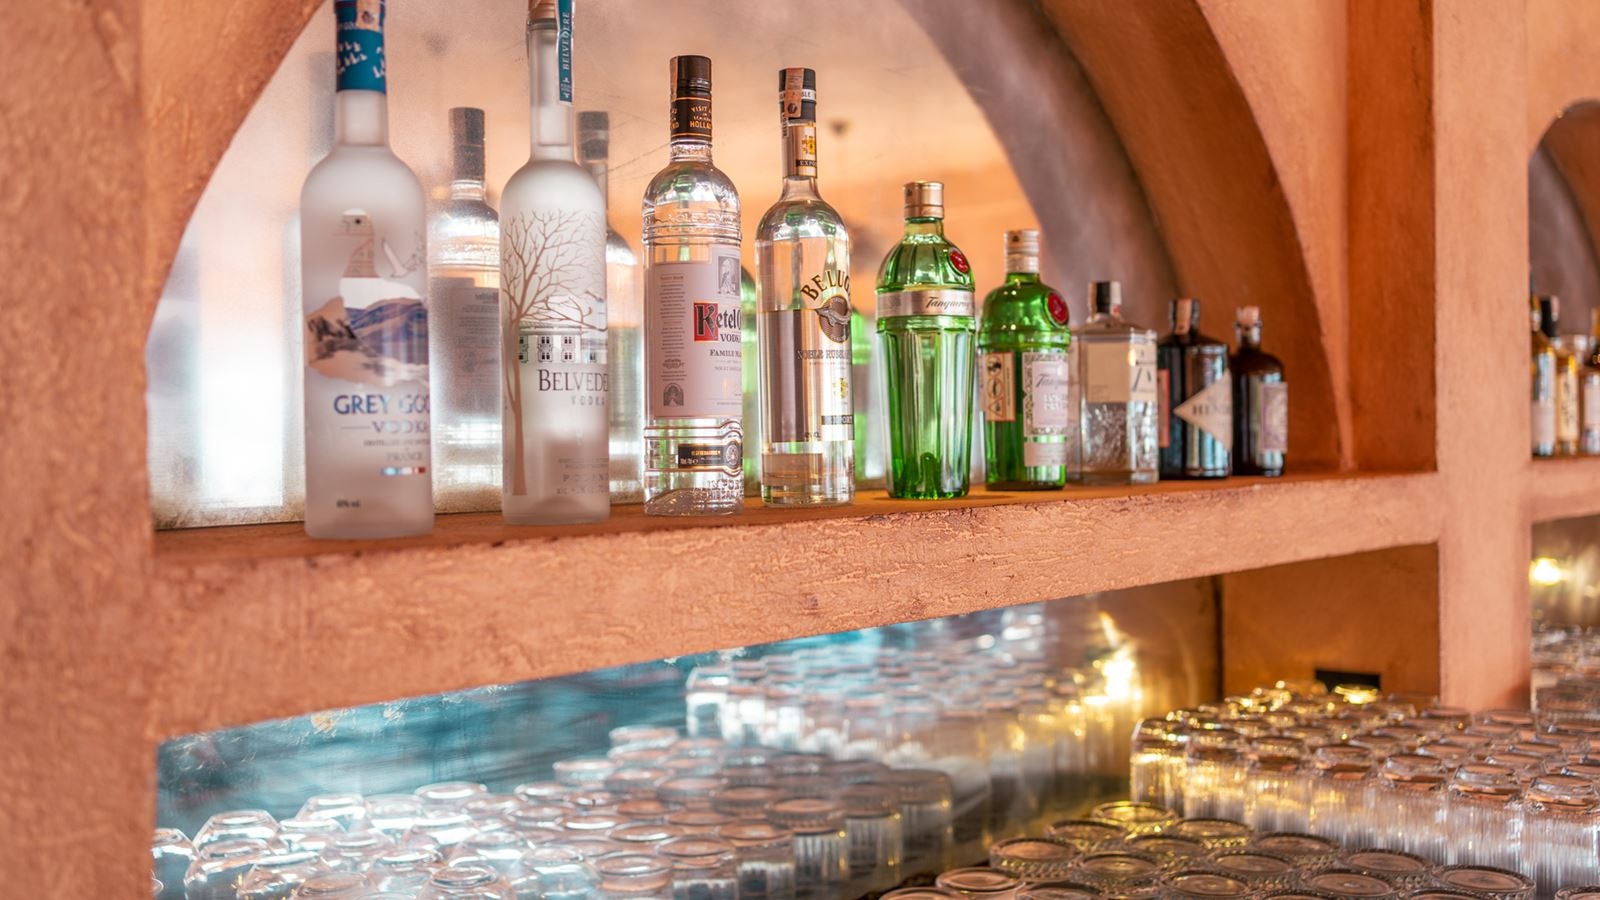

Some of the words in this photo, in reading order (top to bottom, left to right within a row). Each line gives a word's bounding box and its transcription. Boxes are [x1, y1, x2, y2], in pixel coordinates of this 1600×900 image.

[562, 12, 570, 70] BELVEDERE
[801, 269, 850, 301] BELUG
[695, 304, 737, 338] Ketel
[537, 368, 609, 392] BELVEDE
[333, 394, 389, 415] GREY
